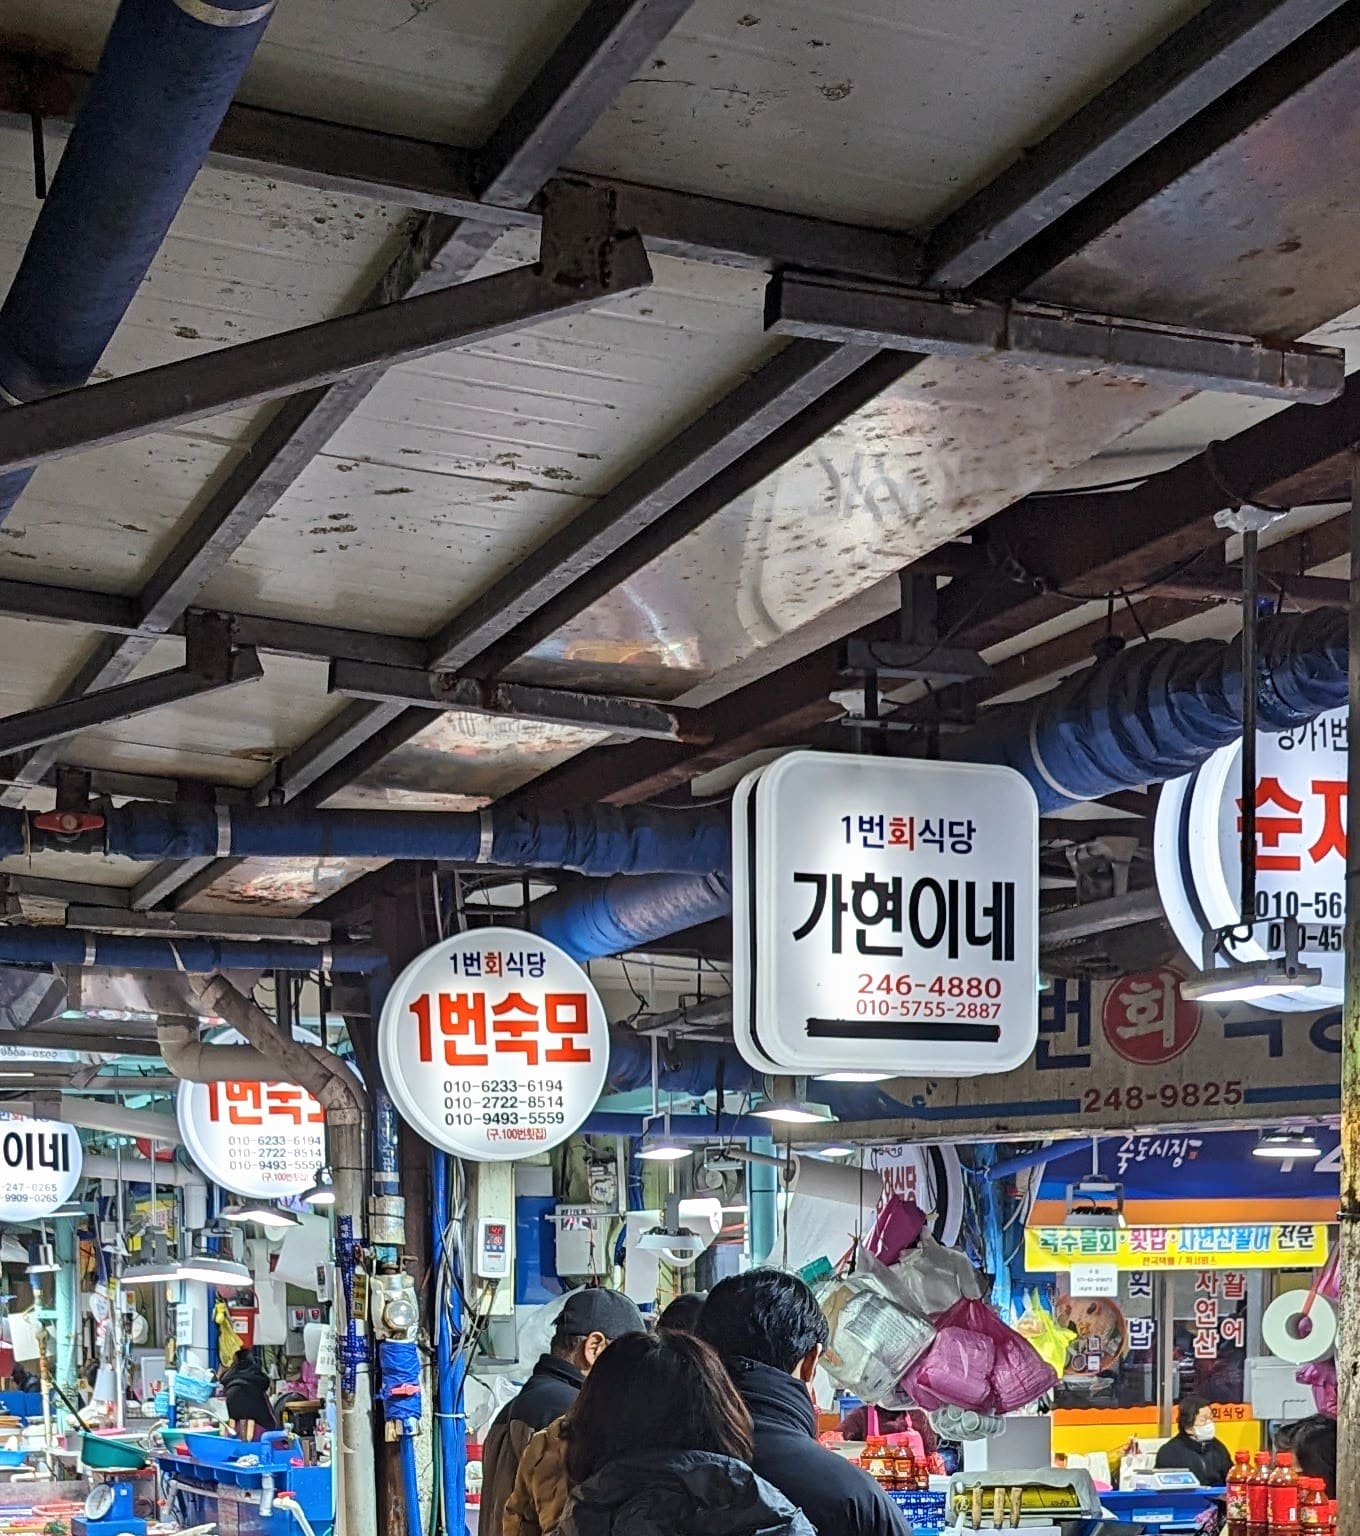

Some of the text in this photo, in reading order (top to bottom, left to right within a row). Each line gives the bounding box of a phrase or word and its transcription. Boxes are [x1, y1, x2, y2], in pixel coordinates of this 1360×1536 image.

[840, 814, 977, 855] 1번회식당
[792, 871, 1015, 961] 가현이네
[450, 952, 546, 978] 1번회식당
[857, 973, 1002, 999] 246-4880
[856, 999, 1002, 1019] 010-5755-2887
[409, 992, 592, 1066] 1번숙모
[443, 1080, 563, 1094] 010-6233-6194
[1083, 1080, 1243, 1114] 248-9825
[444, 1096, 564, 1110] 010-2722-8514
[444, 1111, 565, 1126] 010-9493-5559
[228, 1135, 322, 1146] 010-6233-6194
[228, 1148, 322, 1158] 010-2722-8514
[1117, 1136, 1191, 1175] 죽도시장
